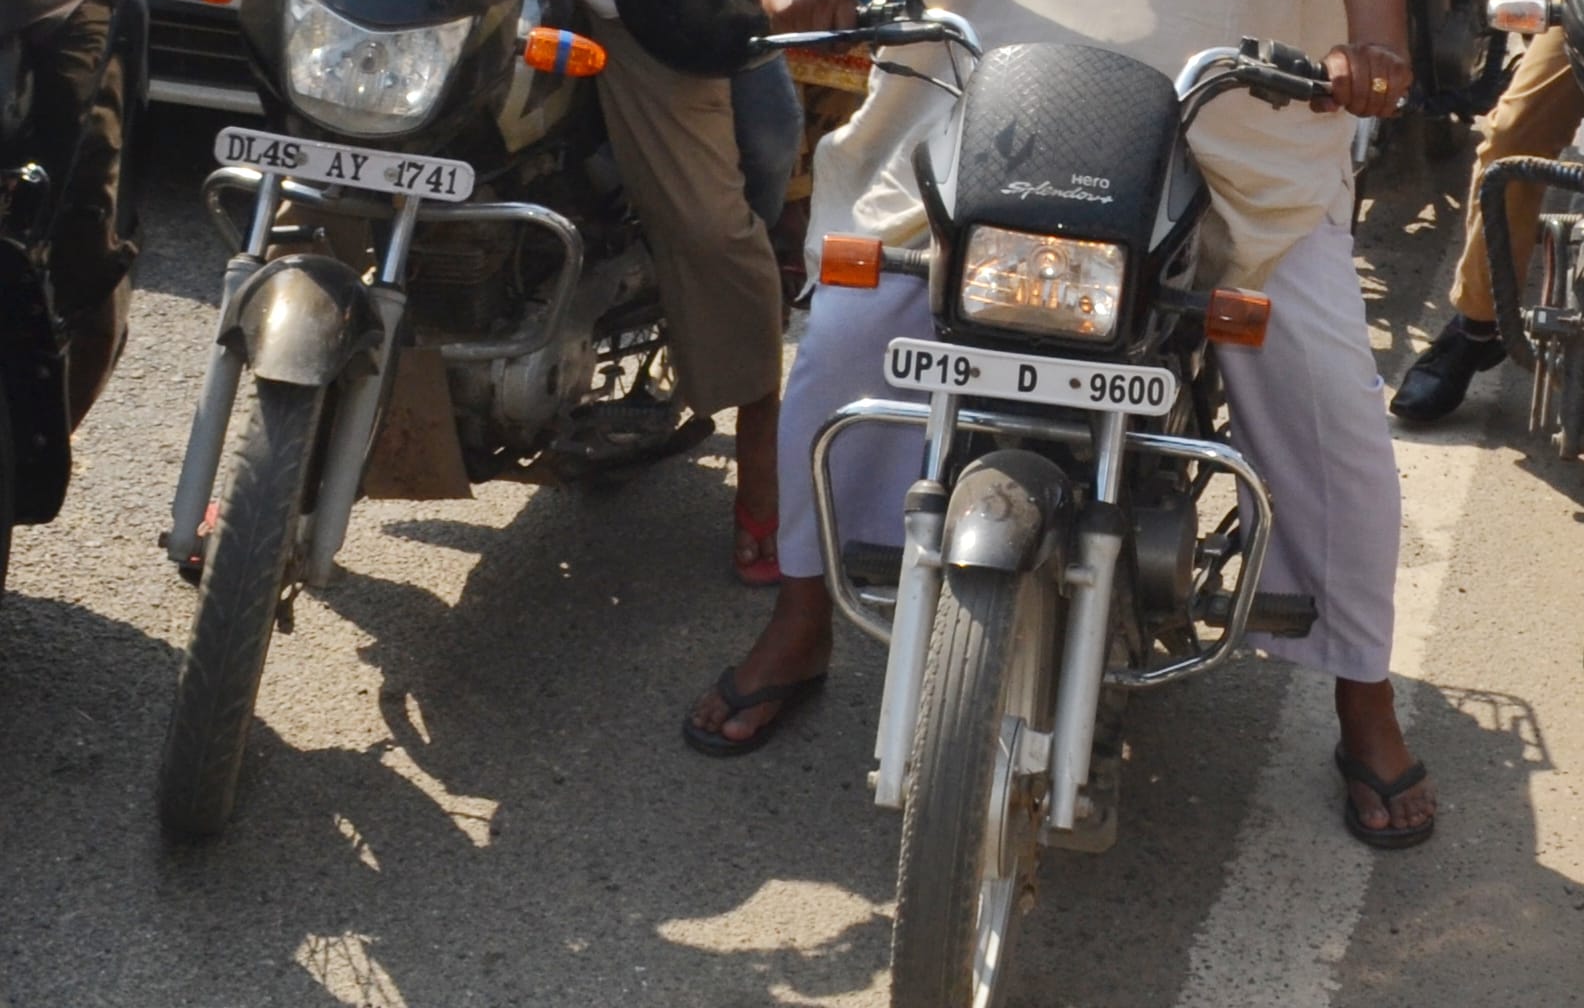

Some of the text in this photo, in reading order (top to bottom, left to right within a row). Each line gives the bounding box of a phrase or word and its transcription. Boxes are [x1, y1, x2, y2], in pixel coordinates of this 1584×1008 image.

[226, 135, 457, 194] DL4S AY 1741
[892, 349, 1164, 406] UP19 D 9600
